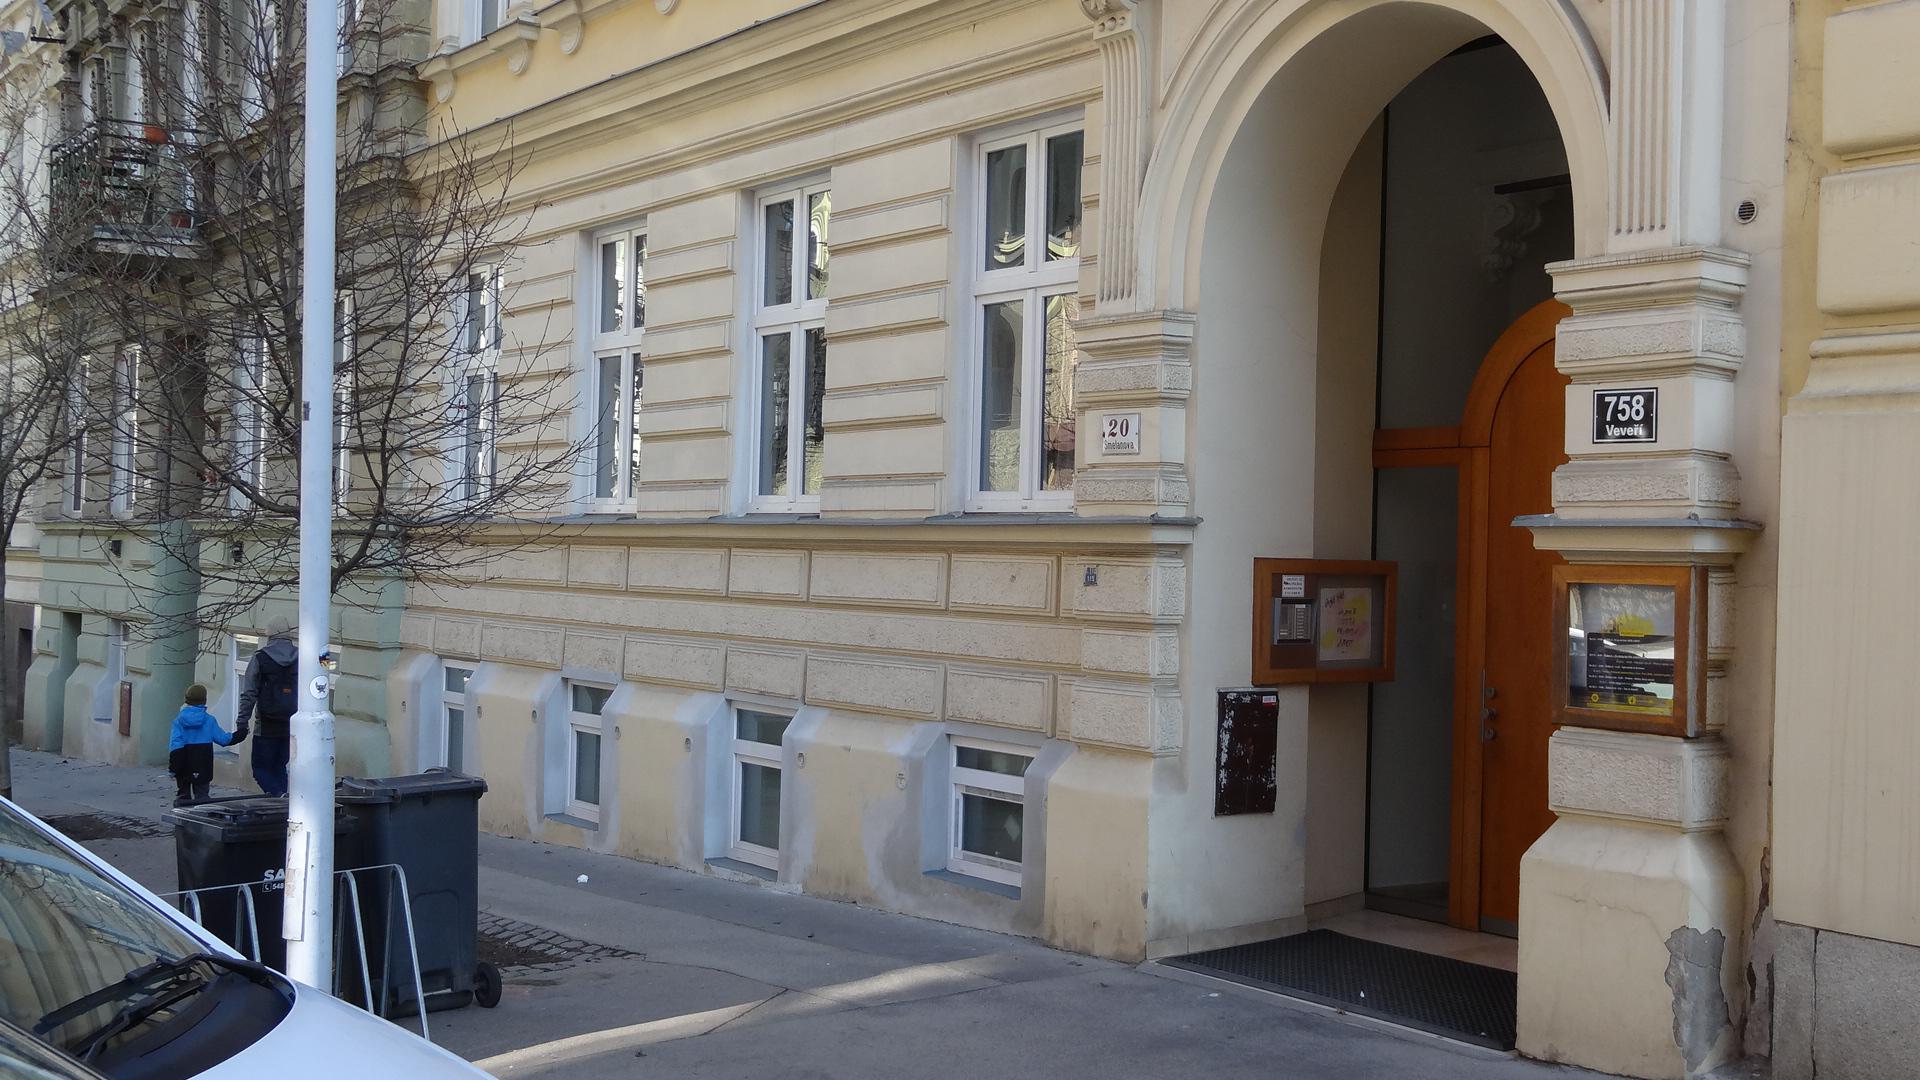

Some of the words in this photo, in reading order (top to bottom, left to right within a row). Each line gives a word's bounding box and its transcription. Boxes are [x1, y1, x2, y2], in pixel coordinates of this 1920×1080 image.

[1604, 394, 1645, 422] 758
[1108, 418, 1129, 437] 20
[1605, 424, 1644, 436] Veveří
